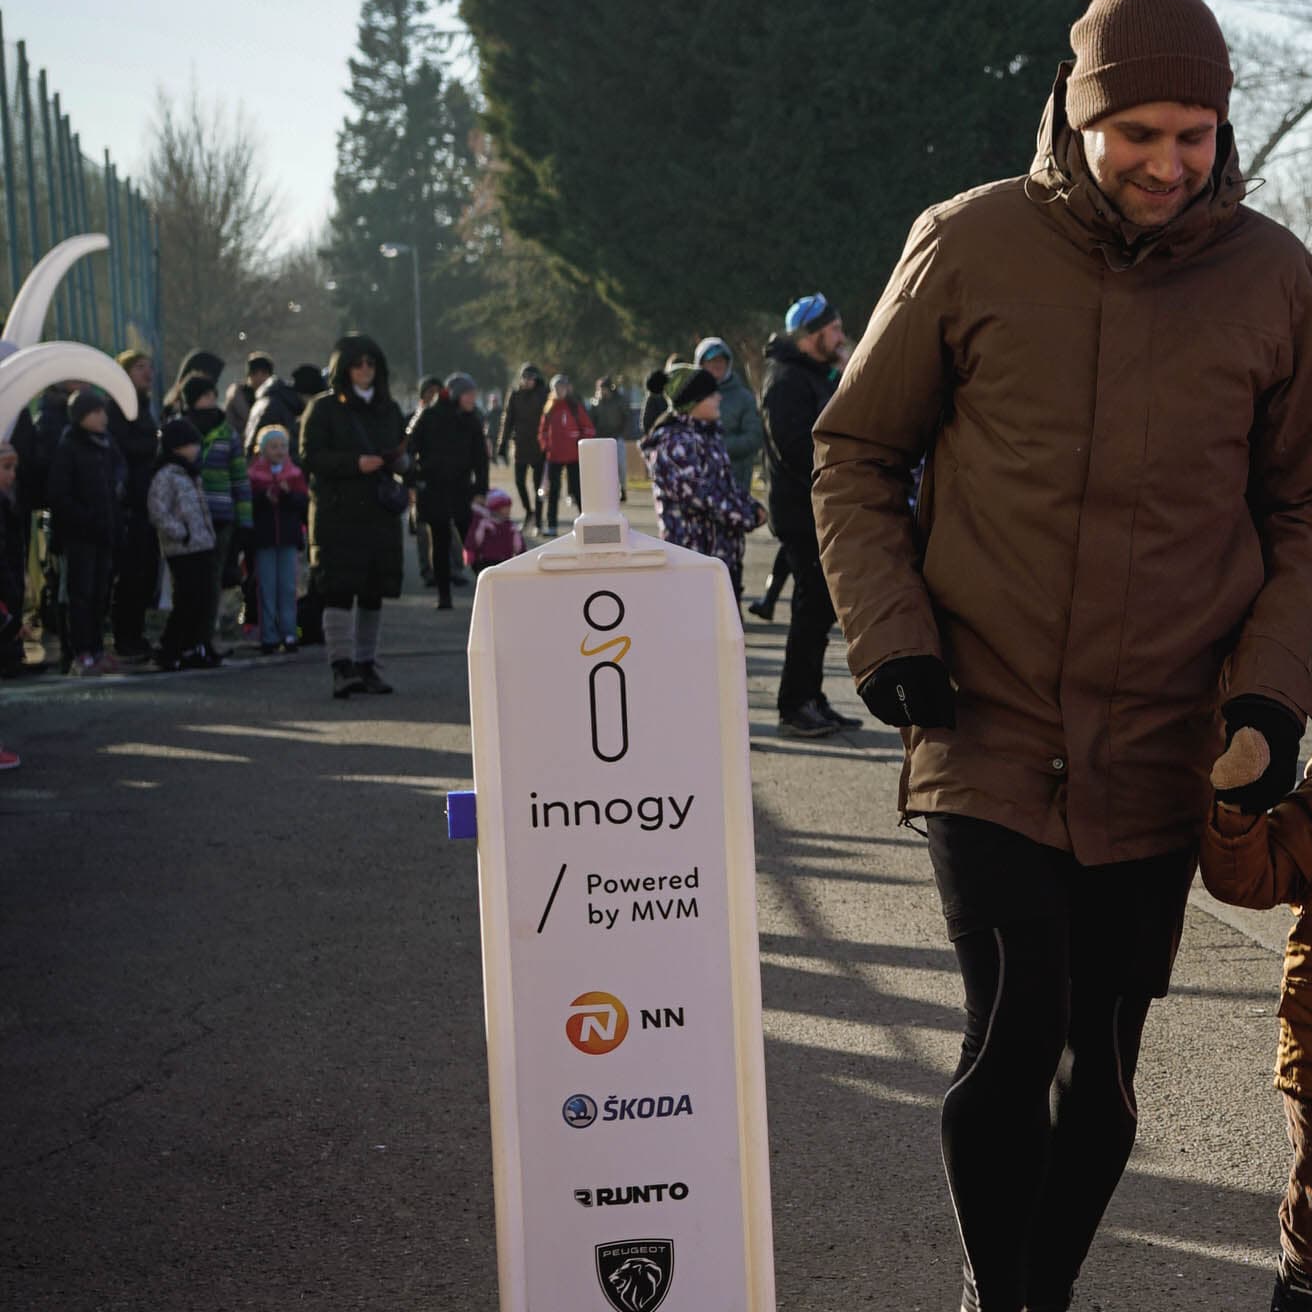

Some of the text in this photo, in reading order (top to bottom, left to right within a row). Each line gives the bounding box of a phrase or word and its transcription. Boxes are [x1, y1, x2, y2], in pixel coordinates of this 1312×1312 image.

[530, 792, 694, 831] innogy
[587, 867, 700, 895] Powered
[588, 898, 699, 929] by MVM
[640, 1007, 684, 1029] NN
[602, 1094, 693, 1121] ŠKODA
[596, 1182, 689, 1206] RUNTO
[602, 1246, 666, 1257] PEUGEOT
